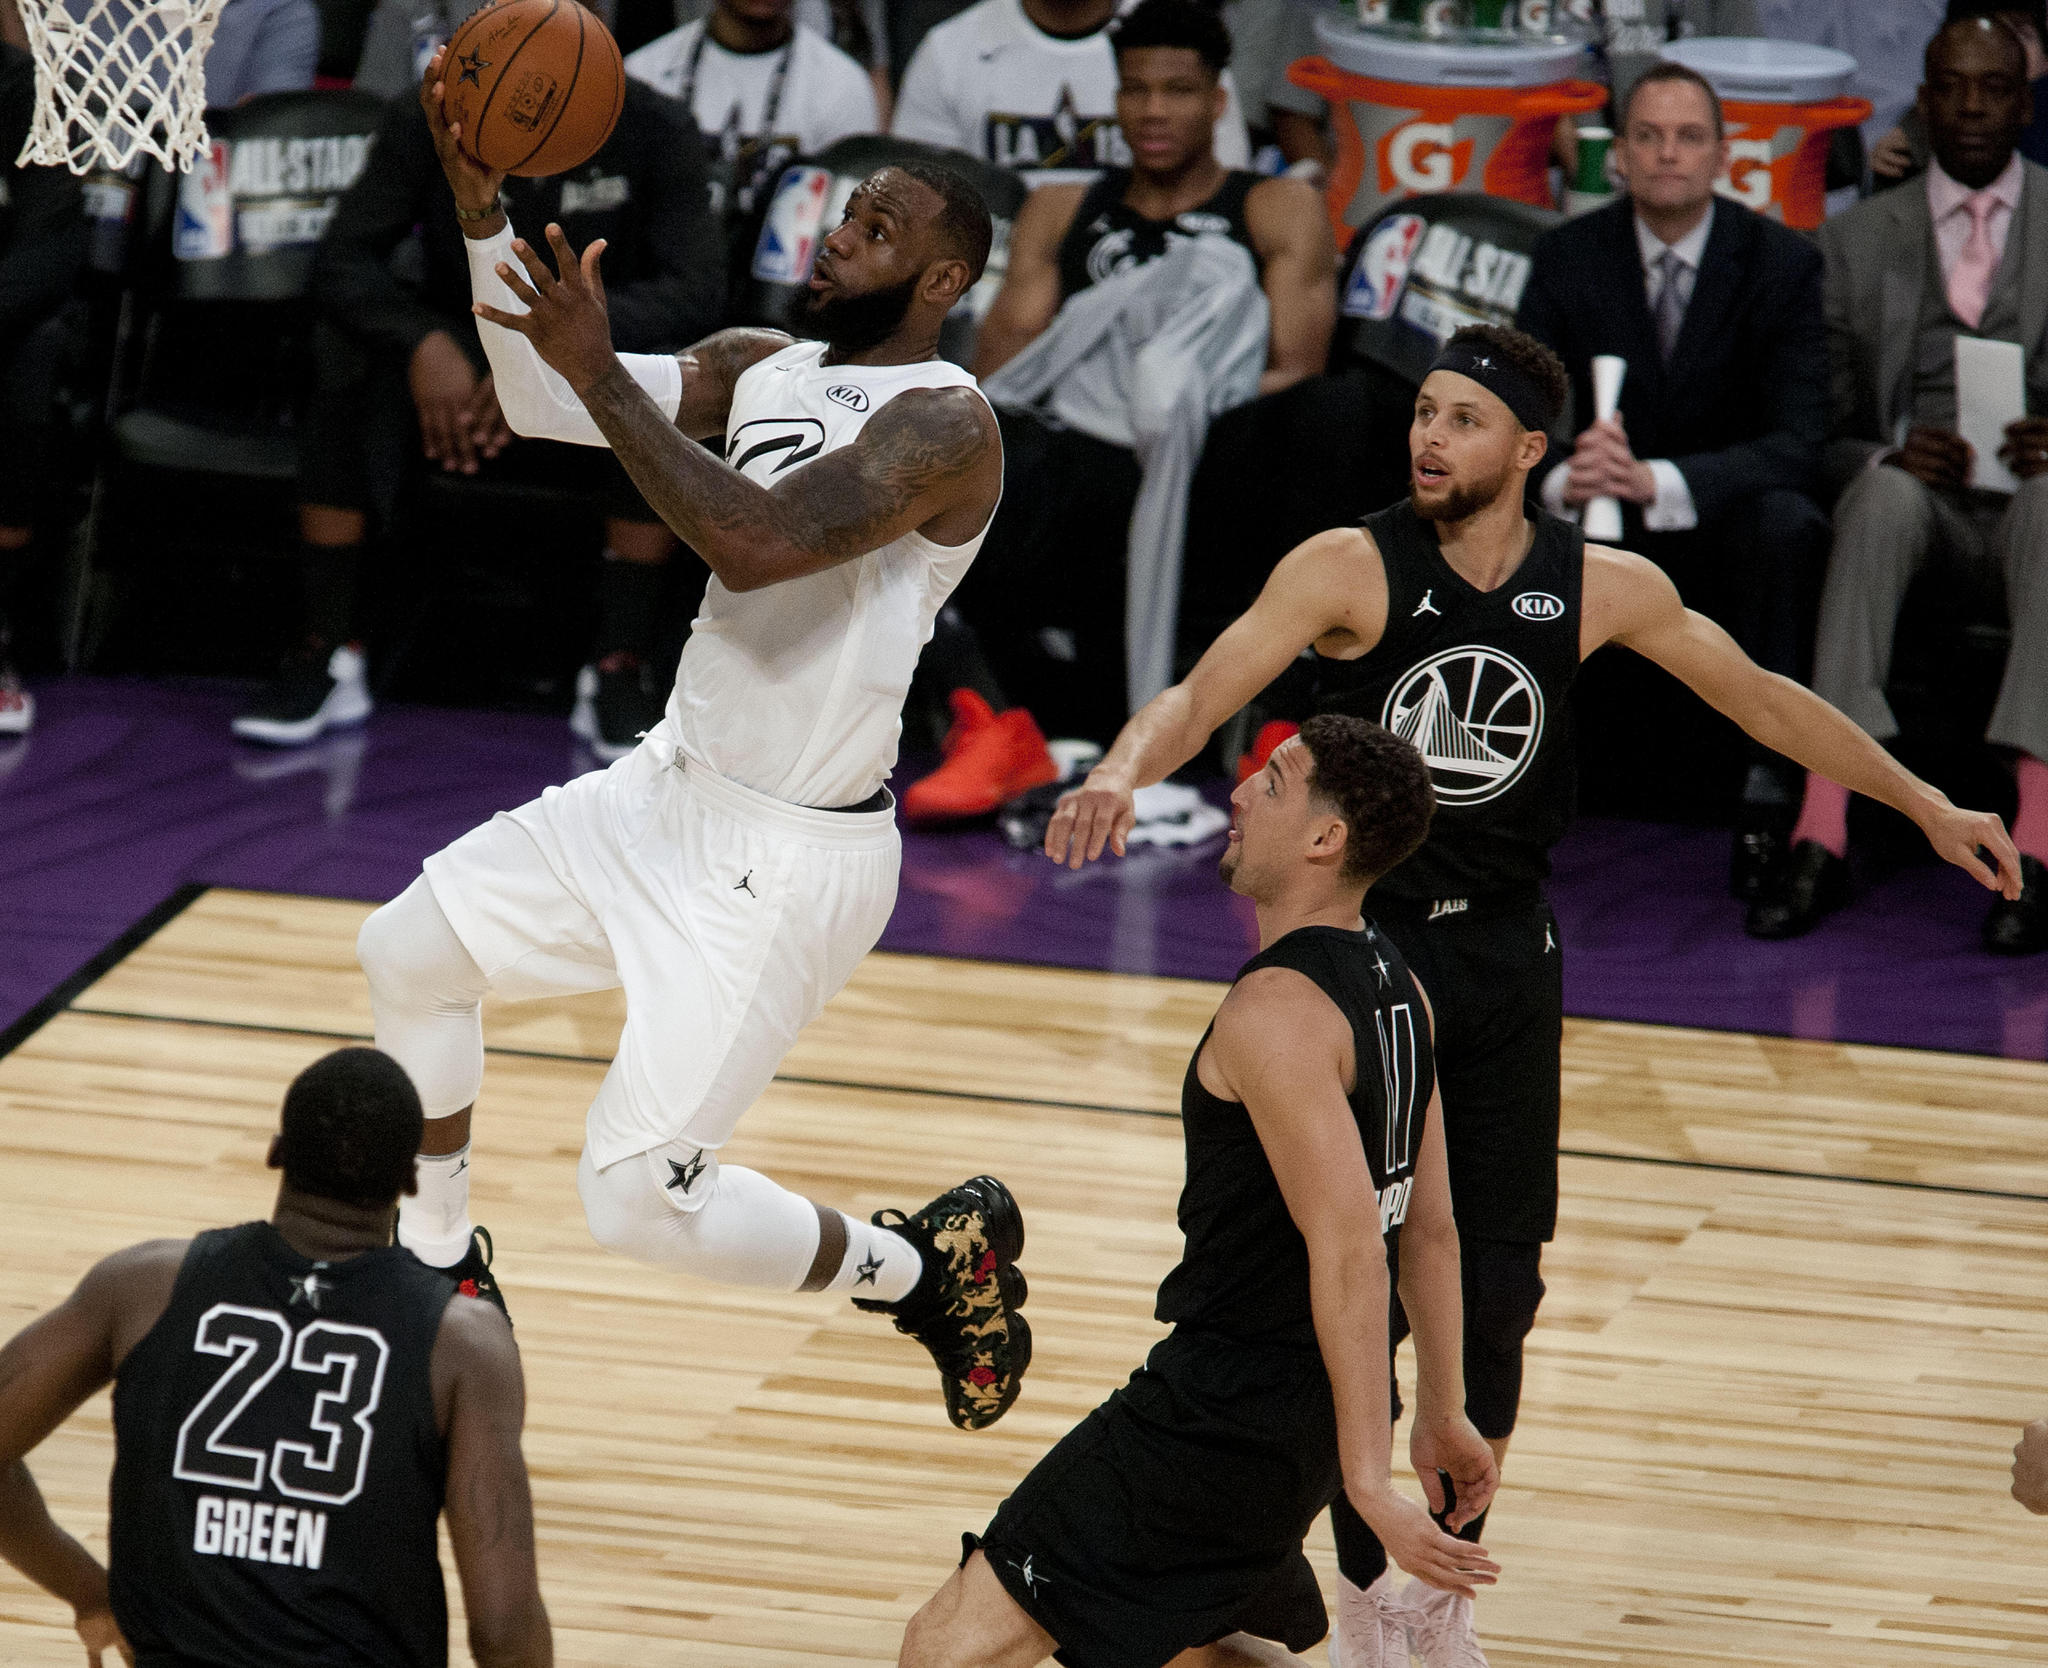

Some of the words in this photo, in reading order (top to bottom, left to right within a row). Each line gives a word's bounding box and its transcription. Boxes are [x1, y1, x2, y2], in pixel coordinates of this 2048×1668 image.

[994, 122, 1039, 166] LA
[1389, 122, 1454, 192] G
[1711, 140, 1772, 207] G
[830, 385, 862, 408] KIA
[1520, 597, 1556, 615] KIA
[173, 1302, 390, 1505] 23
[194, 1495, 327, 1570] GREEN
